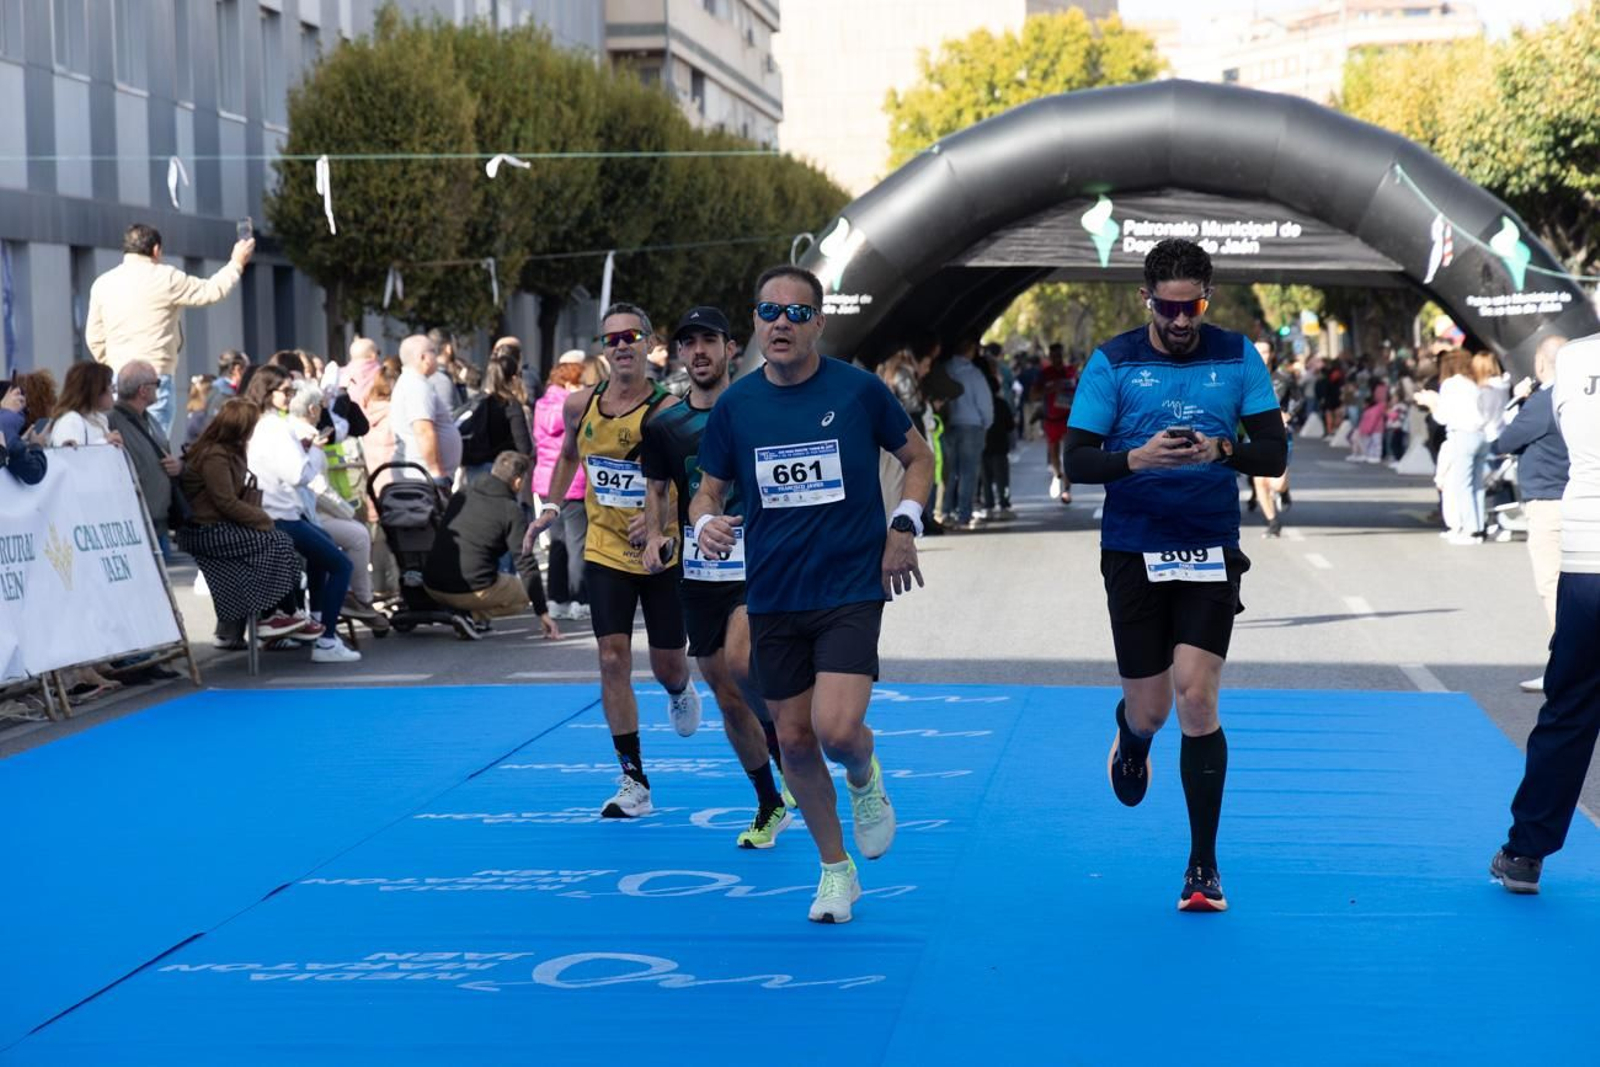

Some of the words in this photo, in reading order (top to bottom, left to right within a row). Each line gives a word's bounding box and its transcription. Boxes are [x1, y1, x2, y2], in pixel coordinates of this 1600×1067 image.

[1123, 219, 1199, 236] Patronato
[1201, 219, 1278, 239] Municipal
[1279, 221, 1302, 237] de
[1220, 238, 1260, 254] Jaén
[596, 470, 635, 490] 947
[772, 460, 822, 485] 661
[250, 972, 472, 981] MEDIA
